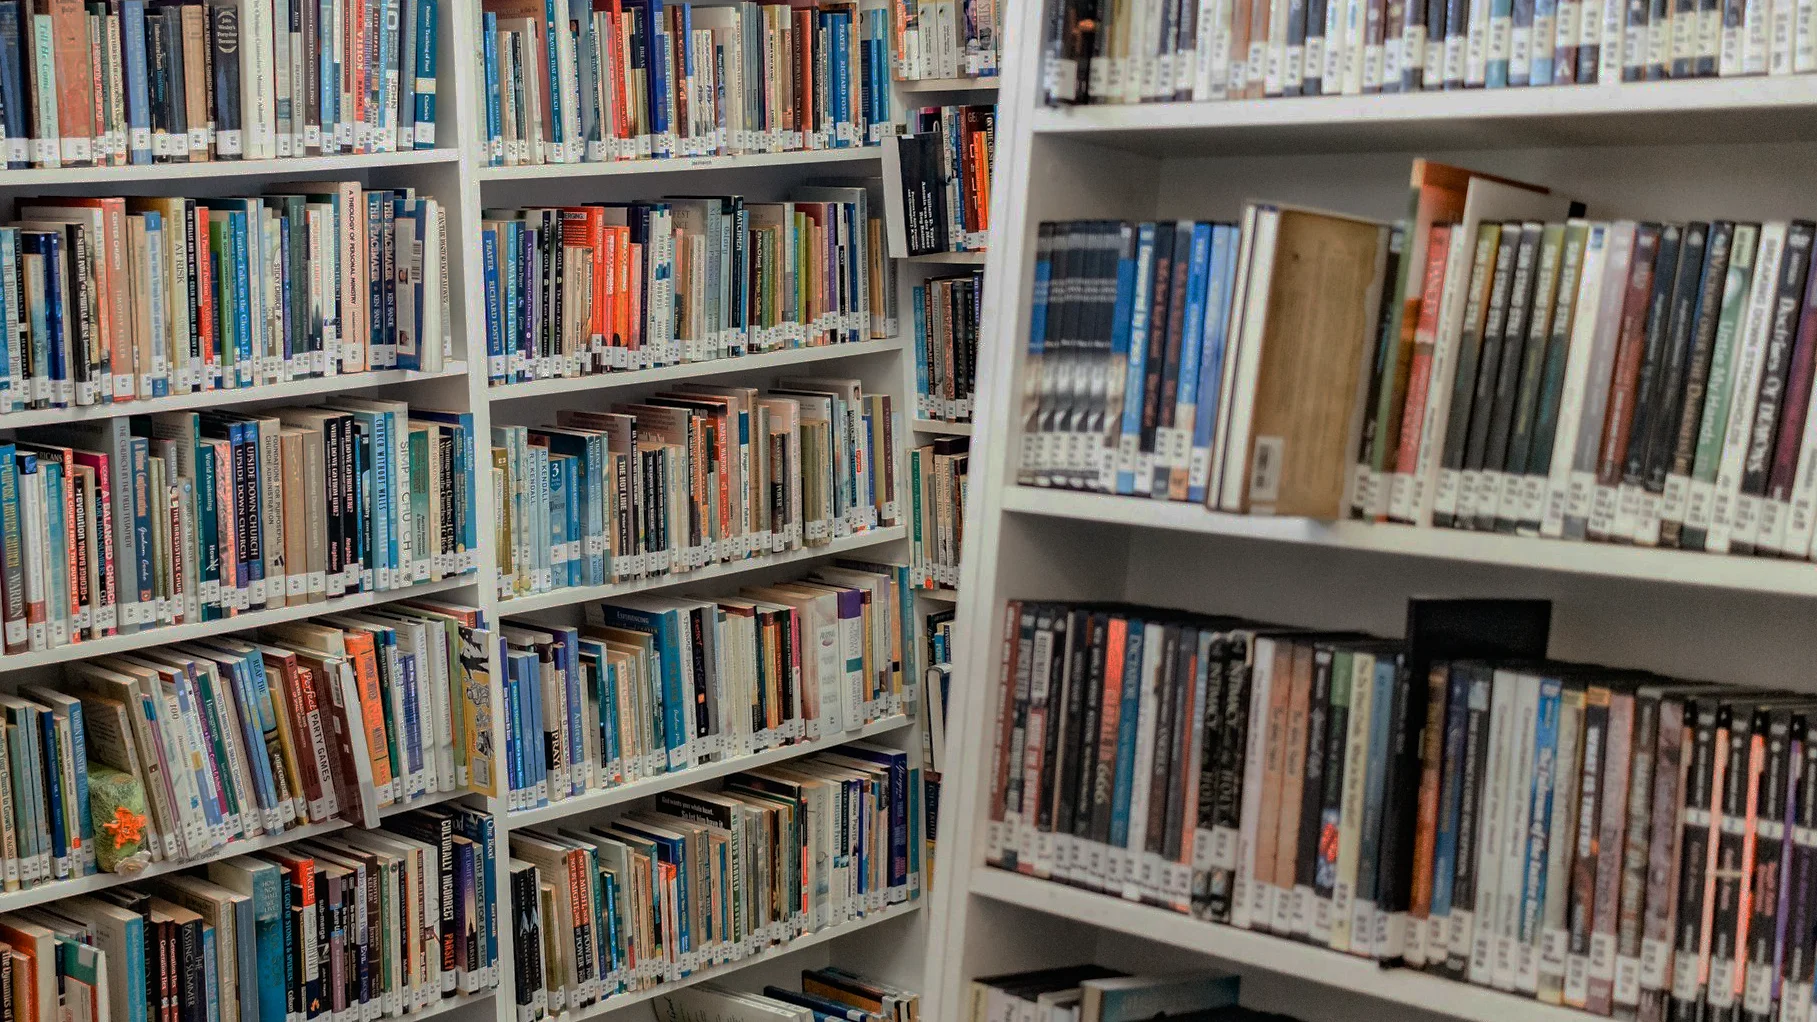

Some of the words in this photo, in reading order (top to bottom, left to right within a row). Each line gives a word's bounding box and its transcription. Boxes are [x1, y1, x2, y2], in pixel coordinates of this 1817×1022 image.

[42, 63, 50, 93] Come
[370, 201, 379, 220] THE
[76, 238, 86, 260] SUBTLE
[175, 243, 183, 258] AT
[349, 232, 355, 241] OF
[113, 240, 121, 270] CHURCH
[370, 223, 381, 283] PEACEMAKER
[78, 260, 86, 281] POWER
[175, 260, 184, 284] RISK
[508, 260, 516, 297] AWAKEN
[79, 290, 88, 319] SPIRITUAL
[115, 290, 124, 325] TIMOTHY
[239, 289, 245, 298] on
[274, 286, 282, 310] CHURCH
[488, 280, 497, 319] RICHARD
[508, 300, 516, 319] THE
[81, 321, 89, 339] ABUSE
[508, 321, 516, 351] DAWN!
[376, 419, 384, 447] CHURCH
[205, 453, 213, 473] World
[247, 446, 256, 480] UPSIDE
[377, 452, 385, 484] WITHOUT
[2, 464, 15, 500] PURPOSE
[102, 490, 110, 498] A
[206, 474, 214, 512] Awakening
[248, 481, 257, 511] DOWN
[541, 465, 549, 503] KENDALL
[3, 501, 18, 534] DRIVEN
[96, 519, 104, 540] THAN
[103, 502, 113, 560] BALANCED
[250, 512, 258, 556] CHURCH
[6, 534, 20, 568] CHURCH
[77, 540, 87, 566] BARNA
[97, 541, 105, 576] NUMBERS
[8, 573, 23, 618] WARREN
[72, 594, 78, 605] IN
[106, 564, 115, 605] CHURCH
[303, 672, 316, 710] Perfect
[311, 713, 323, 744] PARTY
[318, 748, 330, 782] GAMES
[0, 772, 10, 796] Church
[3, 806, 12, 832] Growth
[486, 820, 494, 836] One
[441, 820, 452, 871] CULTURALLY
[307, 867, 315, 900] HAGEE
[580, 870, 585, 878] BY
[443, 875, 454, 920] INCORRECT
[580, 879, 588, 909] MIGHT,
[184, 923, 193, 963] PASSING
[583, 925, 589, 934] BY
[195, 955, 203, 970] THE
[444, 933, 454, 970] PARSLEY
[584, 934, 592, 965] POWER
[186, 966, 194, 1007] SUMMER
